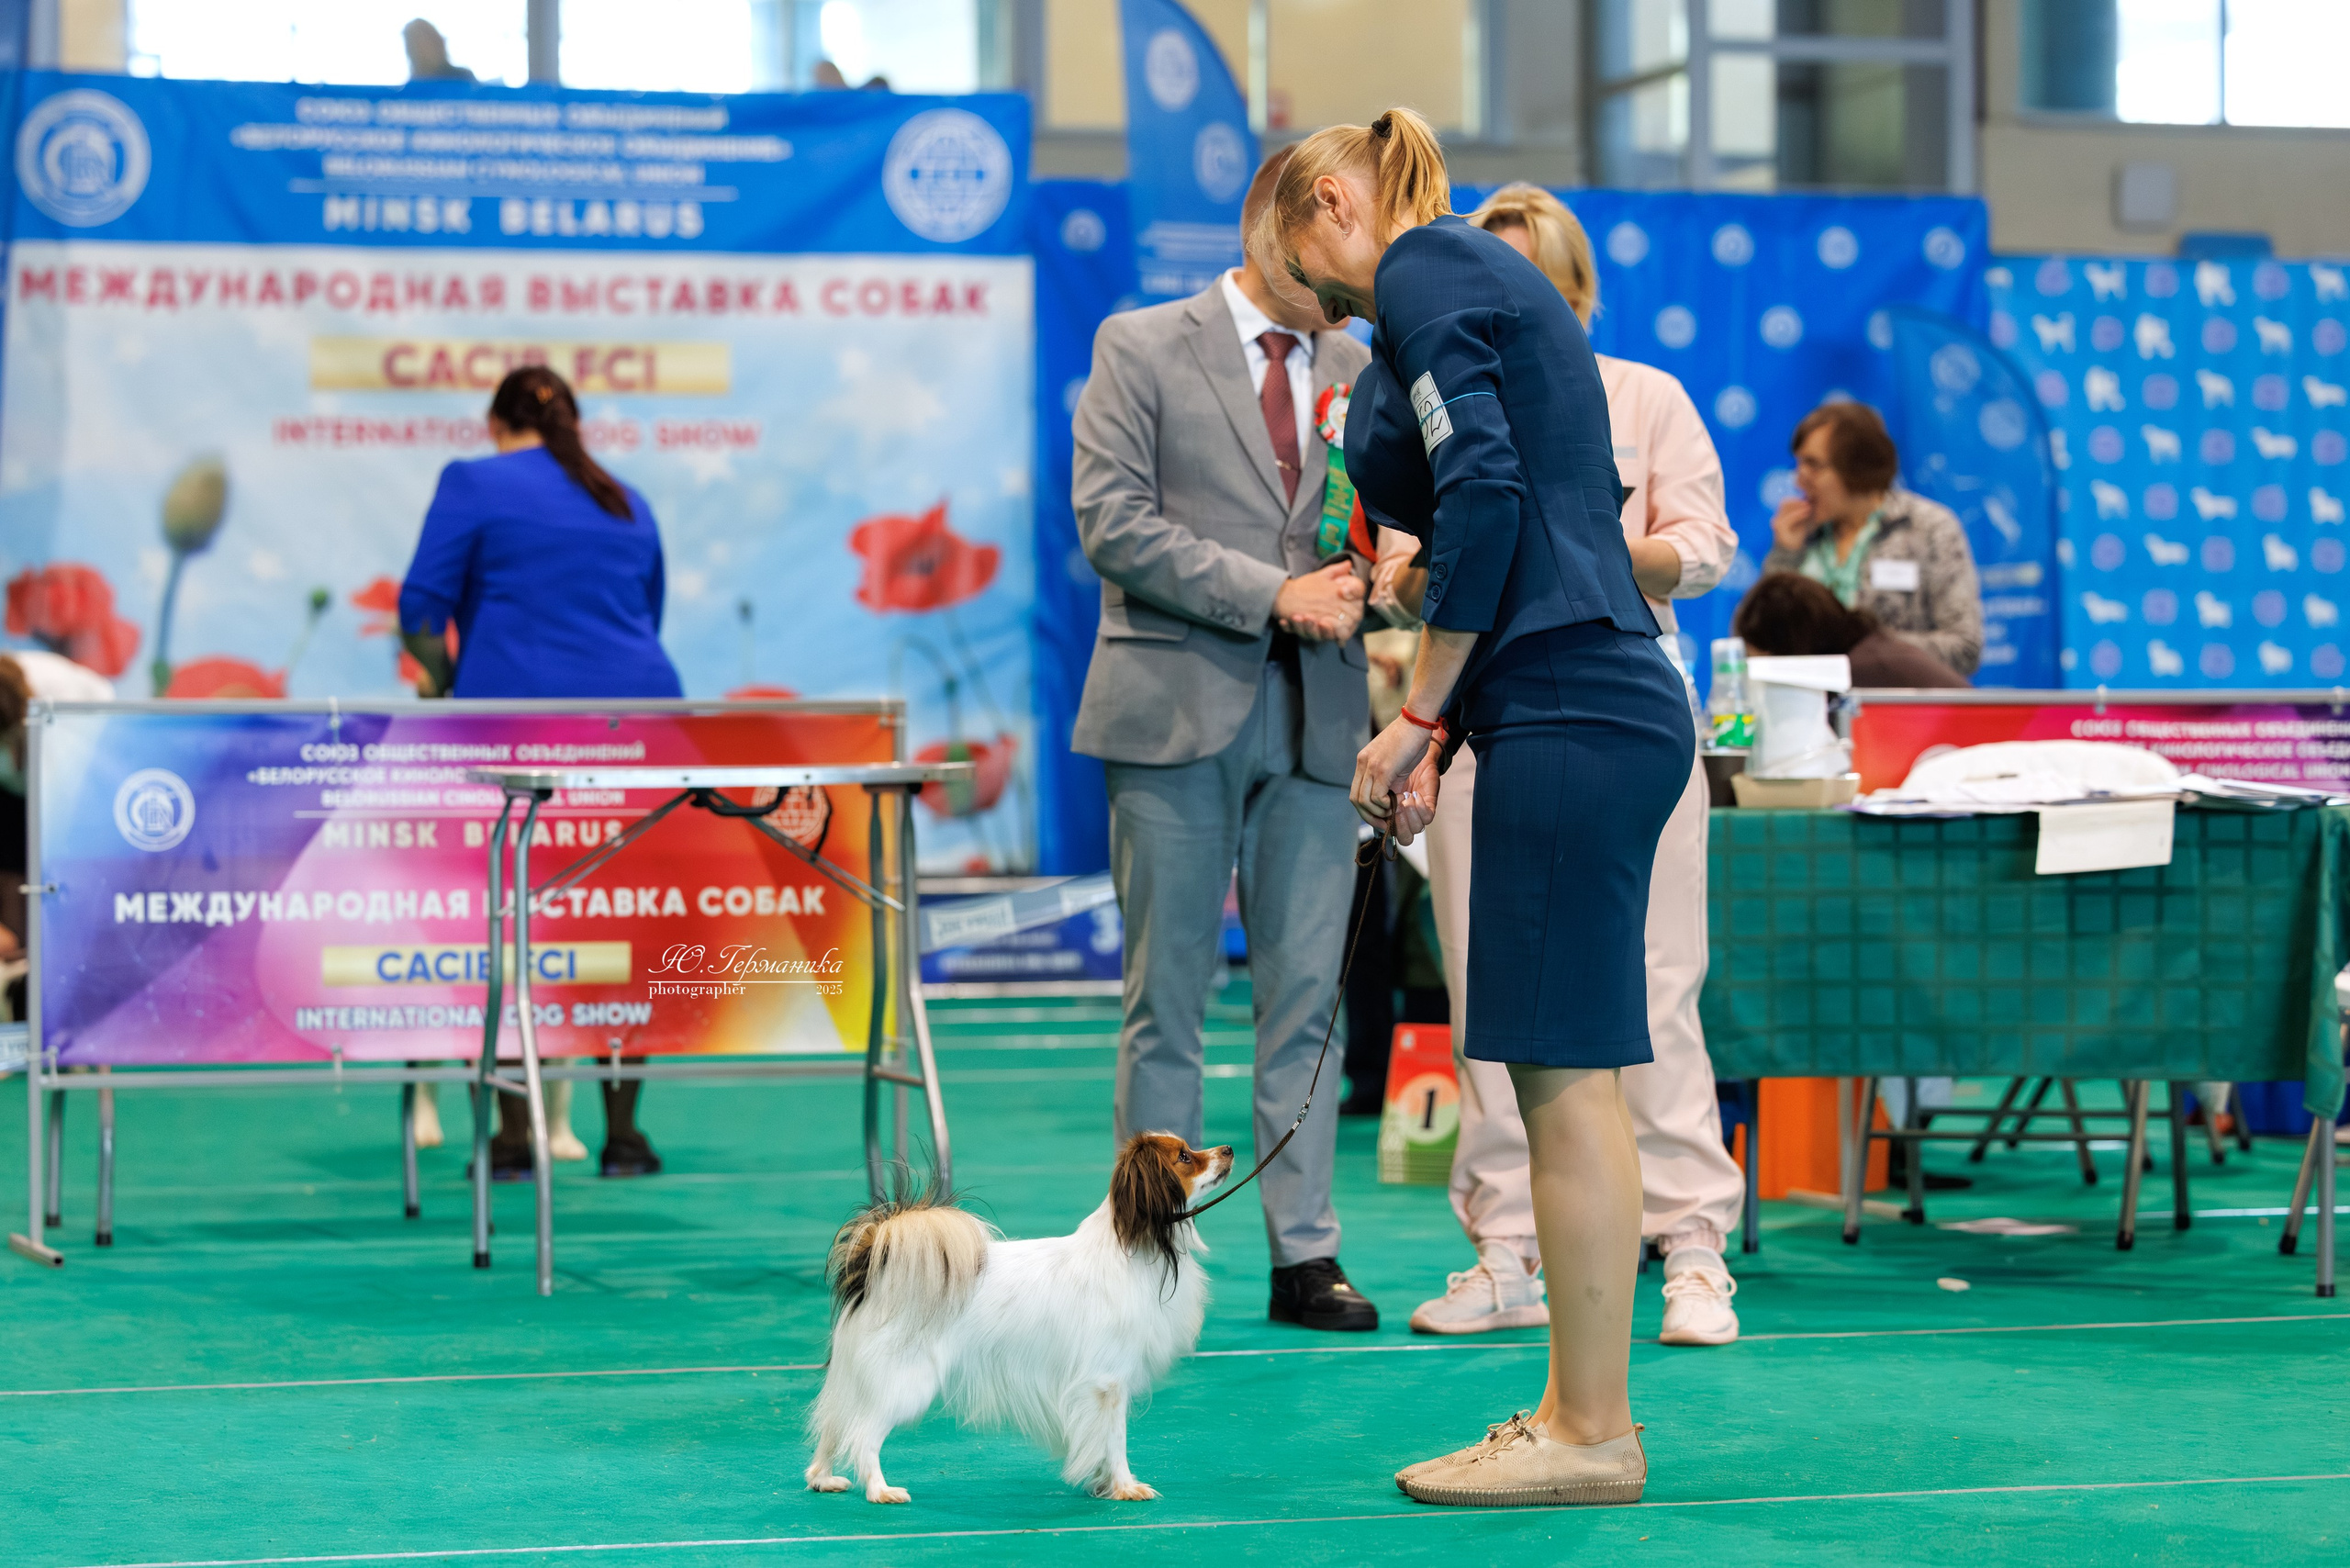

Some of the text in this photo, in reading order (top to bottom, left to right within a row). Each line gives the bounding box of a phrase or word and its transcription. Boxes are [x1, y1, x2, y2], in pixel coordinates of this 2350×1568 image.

[323, 196, 705, 239] MINSK BELARUS
[18, 266, 991, 316] МЕЖДУНАРОДНАЯ ВЫСТАВКА СОБАК
[573, 345, 657, 391] FCI
[300, 743, 360, 763] СОЮЗ
[323, 821, 438, 849] MINSK
[114, 889, 471, 927] МЕЖДУНАРОДНАЯ
[697, 884, 826, 916] СОБАК
[296, 1004, 488, 1030] INTERNATIONA
[570, 1001, 654, 1026] SHOW
